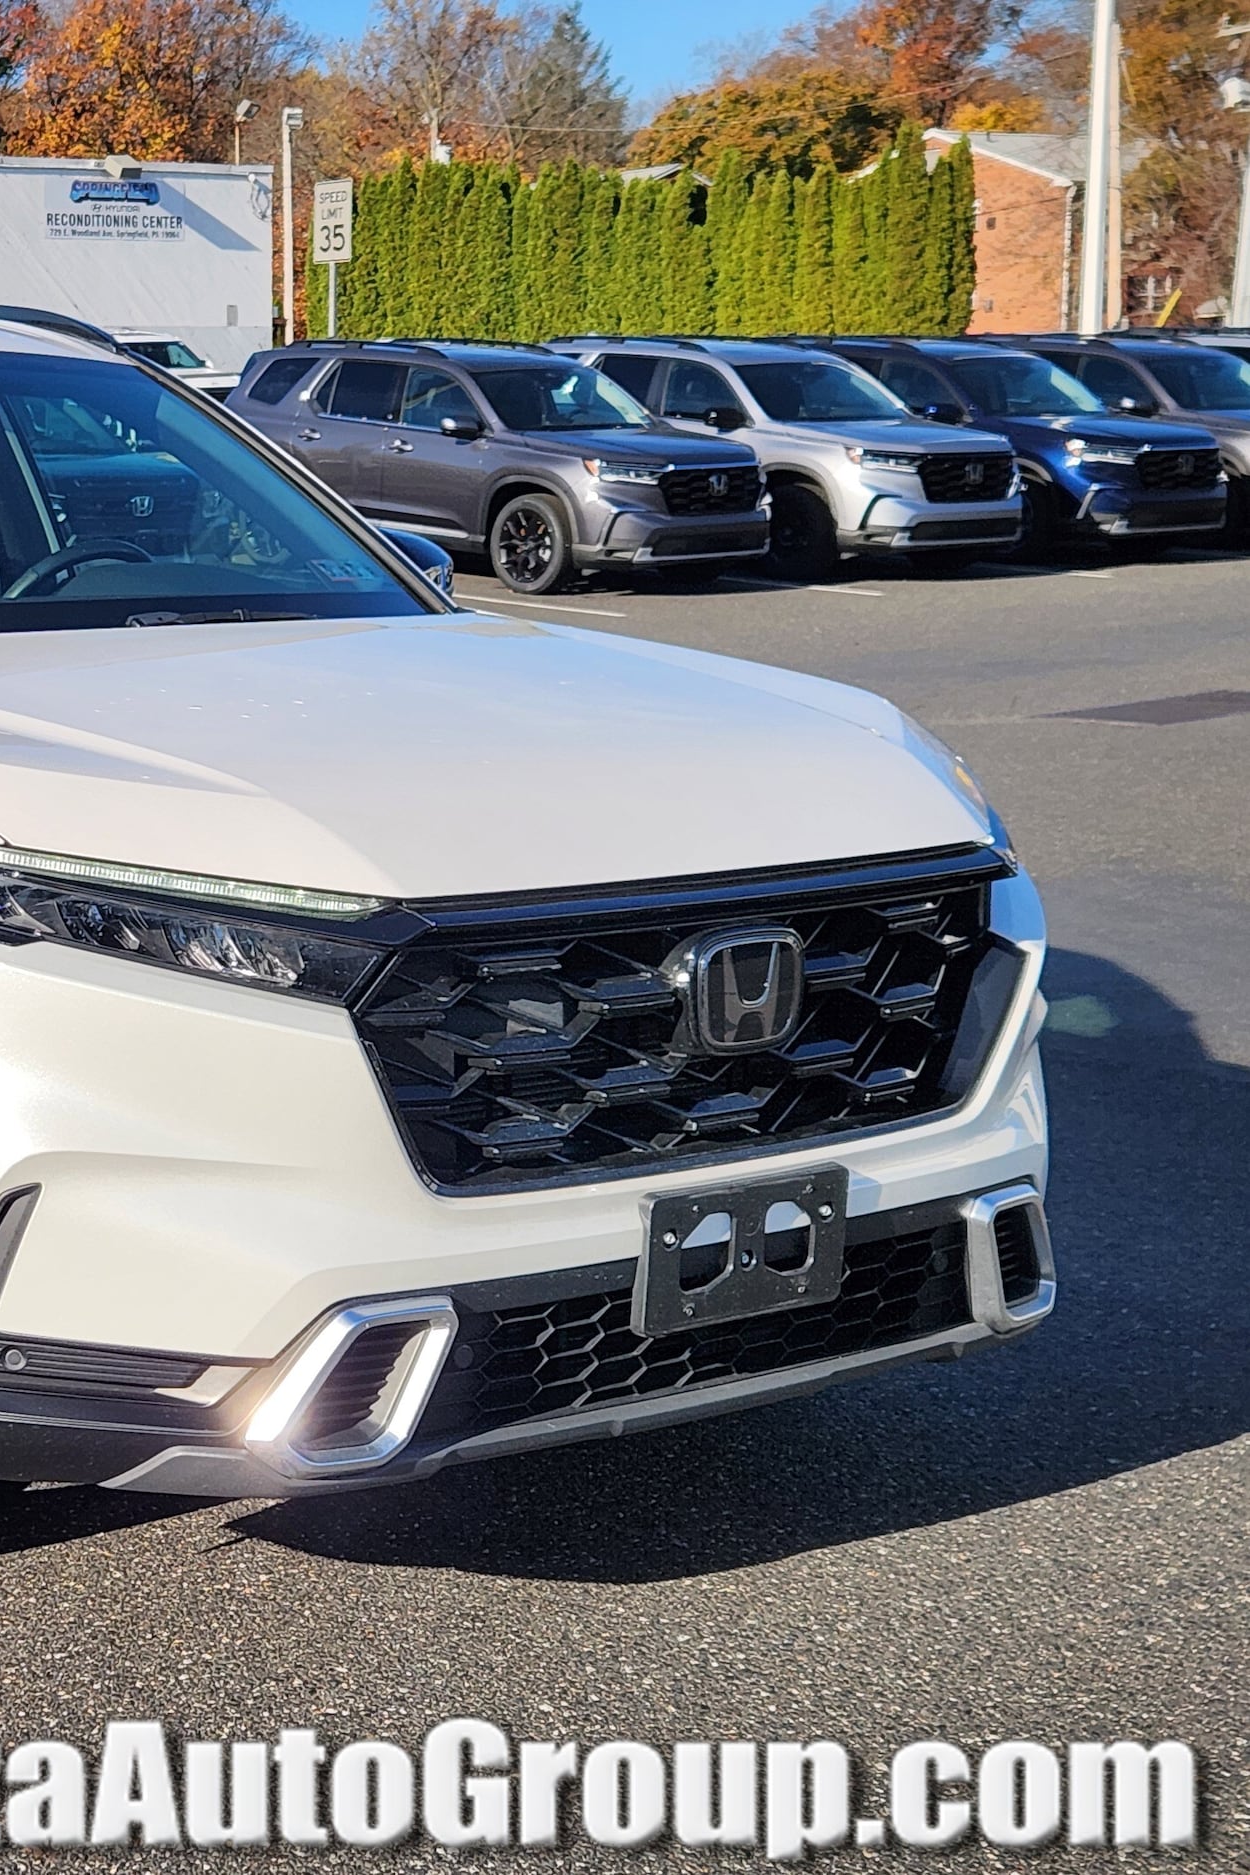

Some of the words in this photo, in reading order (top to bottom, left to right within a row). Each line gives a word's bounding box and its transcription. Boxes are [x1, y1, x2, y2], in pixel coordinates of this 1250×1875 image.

[319, 190, 348, 204] SPEED
[46, 212, 139, 228] RECONDITIONING
[141, 215, 183, 229] CENTER
[321, 207, 343, 220] LIMIT
[319, 224, 346, 253] 35
